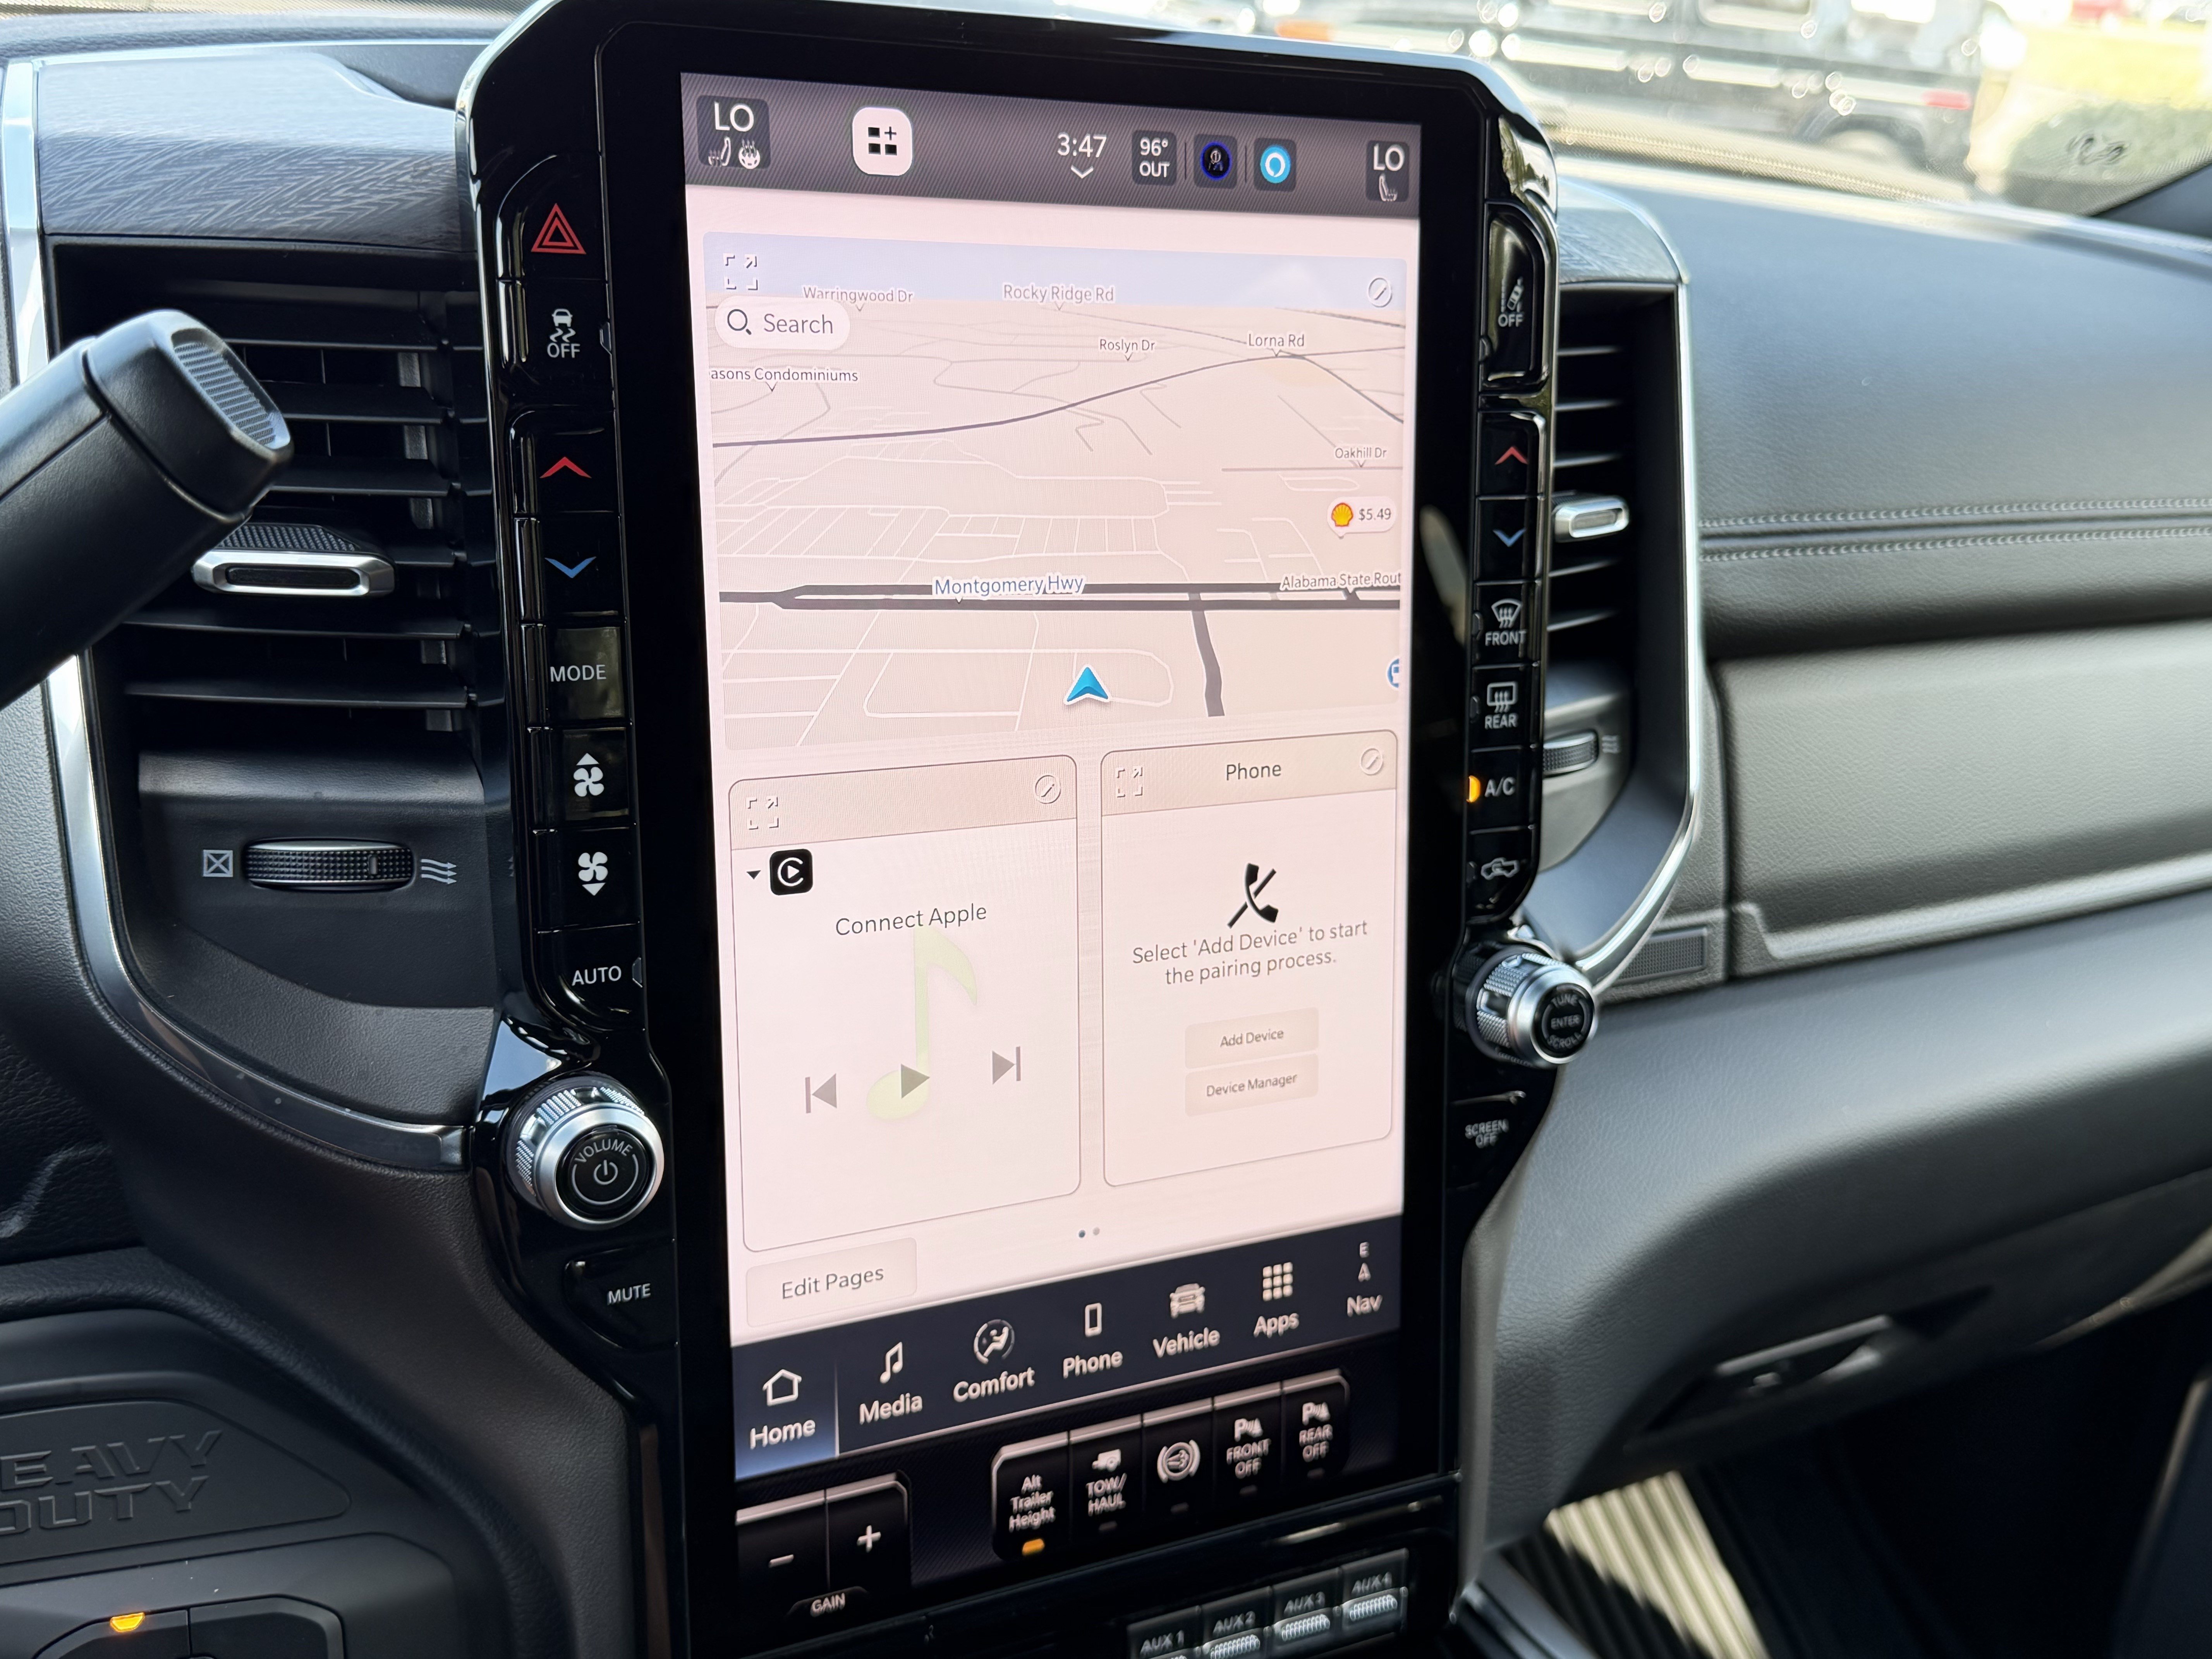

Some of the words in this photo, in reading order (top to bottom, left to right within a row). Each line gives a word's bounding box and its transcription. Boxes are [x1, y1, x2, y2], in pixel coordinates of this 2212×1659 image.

[714, 101, 755, 132] LO
[1057, 134, 1107, 158] 3:47
[1140, 137, 1168, 156] 96°
[1373, 144, 1405, 171] LO
[1140, 163, 1170, 178] OUT
[803, 287, 893, 304] Warringwood
[898, 290, 913, 302] Dr
[1004, 285, 1047, 303] Rocky
[1051, 286, 1092, 304] Ridge
[1096, 287, 1114, 301] Rd
[764, 314, 833, 334] Search
[1498, 313, 1523, 327] OFF
[547, 342, 580, 358] OFF
[1100, 339, 1137, 353] Roslyn
[1142, 340, 1156, 351] Dr
[1249, 334, 1284, 347] Lorna
[1288, 334, 1305, 347] Rd
[755, 368, 858, 382] Condominiums
[1335, 447, 1371, 459] Oakhill
[1375, 447, 1387, 458] Dr
[1358, 508, 1391, 521] $5.49
[935, 578, 1044, 596] Montgomery
[1048, 575, 1084, 593] Hwy
[1282, 575, 1336, 588] Alabama
[1340, 573, 1370, 586] State
[1485, 629, 1527, 646] FRONT
[550, 665, 606, 682] MODE
[1485, 715, 1518, 729] REAR
[1226, 762, 1282, 781] Phone
[1484, 777, 1515, 797] A/C
[836, 910, 923, 936] Connect
[929, 903, 987, 929] Apple
[1133, 942, 1187, 964] Select
[1194, 935, 1233, 955] 'Add
[1240, 926, 1302, 950] Device'
[1309, 926, 1324, 941] to
[1329, 920, 1367, 939] start
[572, 965, 622, 986] AUTO
[1165, 967, 1194, 984] the
[1200, 958, 1261, 984] pairing
[1267, 950, 1337, 975] process.
[1551, 994, 1580, 1007] TUNE
[1551, 1015, 1582, 1030] ENTER
[1220, 1034, 1242, 1047] Add
[1246, 1029, 1284, 1043] Device
[1547, 1032, 1583, 1049] SCROLL
[1207, 1081, 1245, 1097] Device
[1248, 1073, 1297, 1089] Manager
[1465, 1119, 1509, 1139] SCREEN
[575, 1138, 633, 1163] VOLUME
[1475, 1133, 1498, 1149] OFF
[782, 1277, 820, 1299] Edit
[826, 1267, 884, 1290] Pages
[606, 1283, 651, 1305] MUTE
[1346, 1295, 1382, 1317] Nav
[1254, 1312, 1299, 1338] Apps
[1153, 1327, 1221, 1358] Vehicle
[1063, 1349, 1123, 1379] Phone
[953, 1367, 1035, 1402] Comfort
[859, 1393, 923, 1424] Media
[750, 1418, 816, 1449] Home
[1299, 1424, 1333, 1446] REAR
[1227, 1438, 1271, 1465] FRONT
[1303, 1441, 1329, 1462] OFF
[1235, 1458, 1262, 1479] OFF
[1021, 1474, 1042, 1493] Alt
[1086, 1474, 1128, 1498] TOW/
[1010, 1491, 1054, 1513] Trailer
[1088, 1496, 1126, 1516] HAUL
[1009, 1506, 1056, 1533] Height
[1352, 1574, 1380, 1594] AUX
[810, 1592, 845, 1618] GAIN
[1284, 1595, 1313, 1616] AUX
[1213, 1615, 1242, 1636] AUX
[1140, 1632, 1174, 1656] AUX
